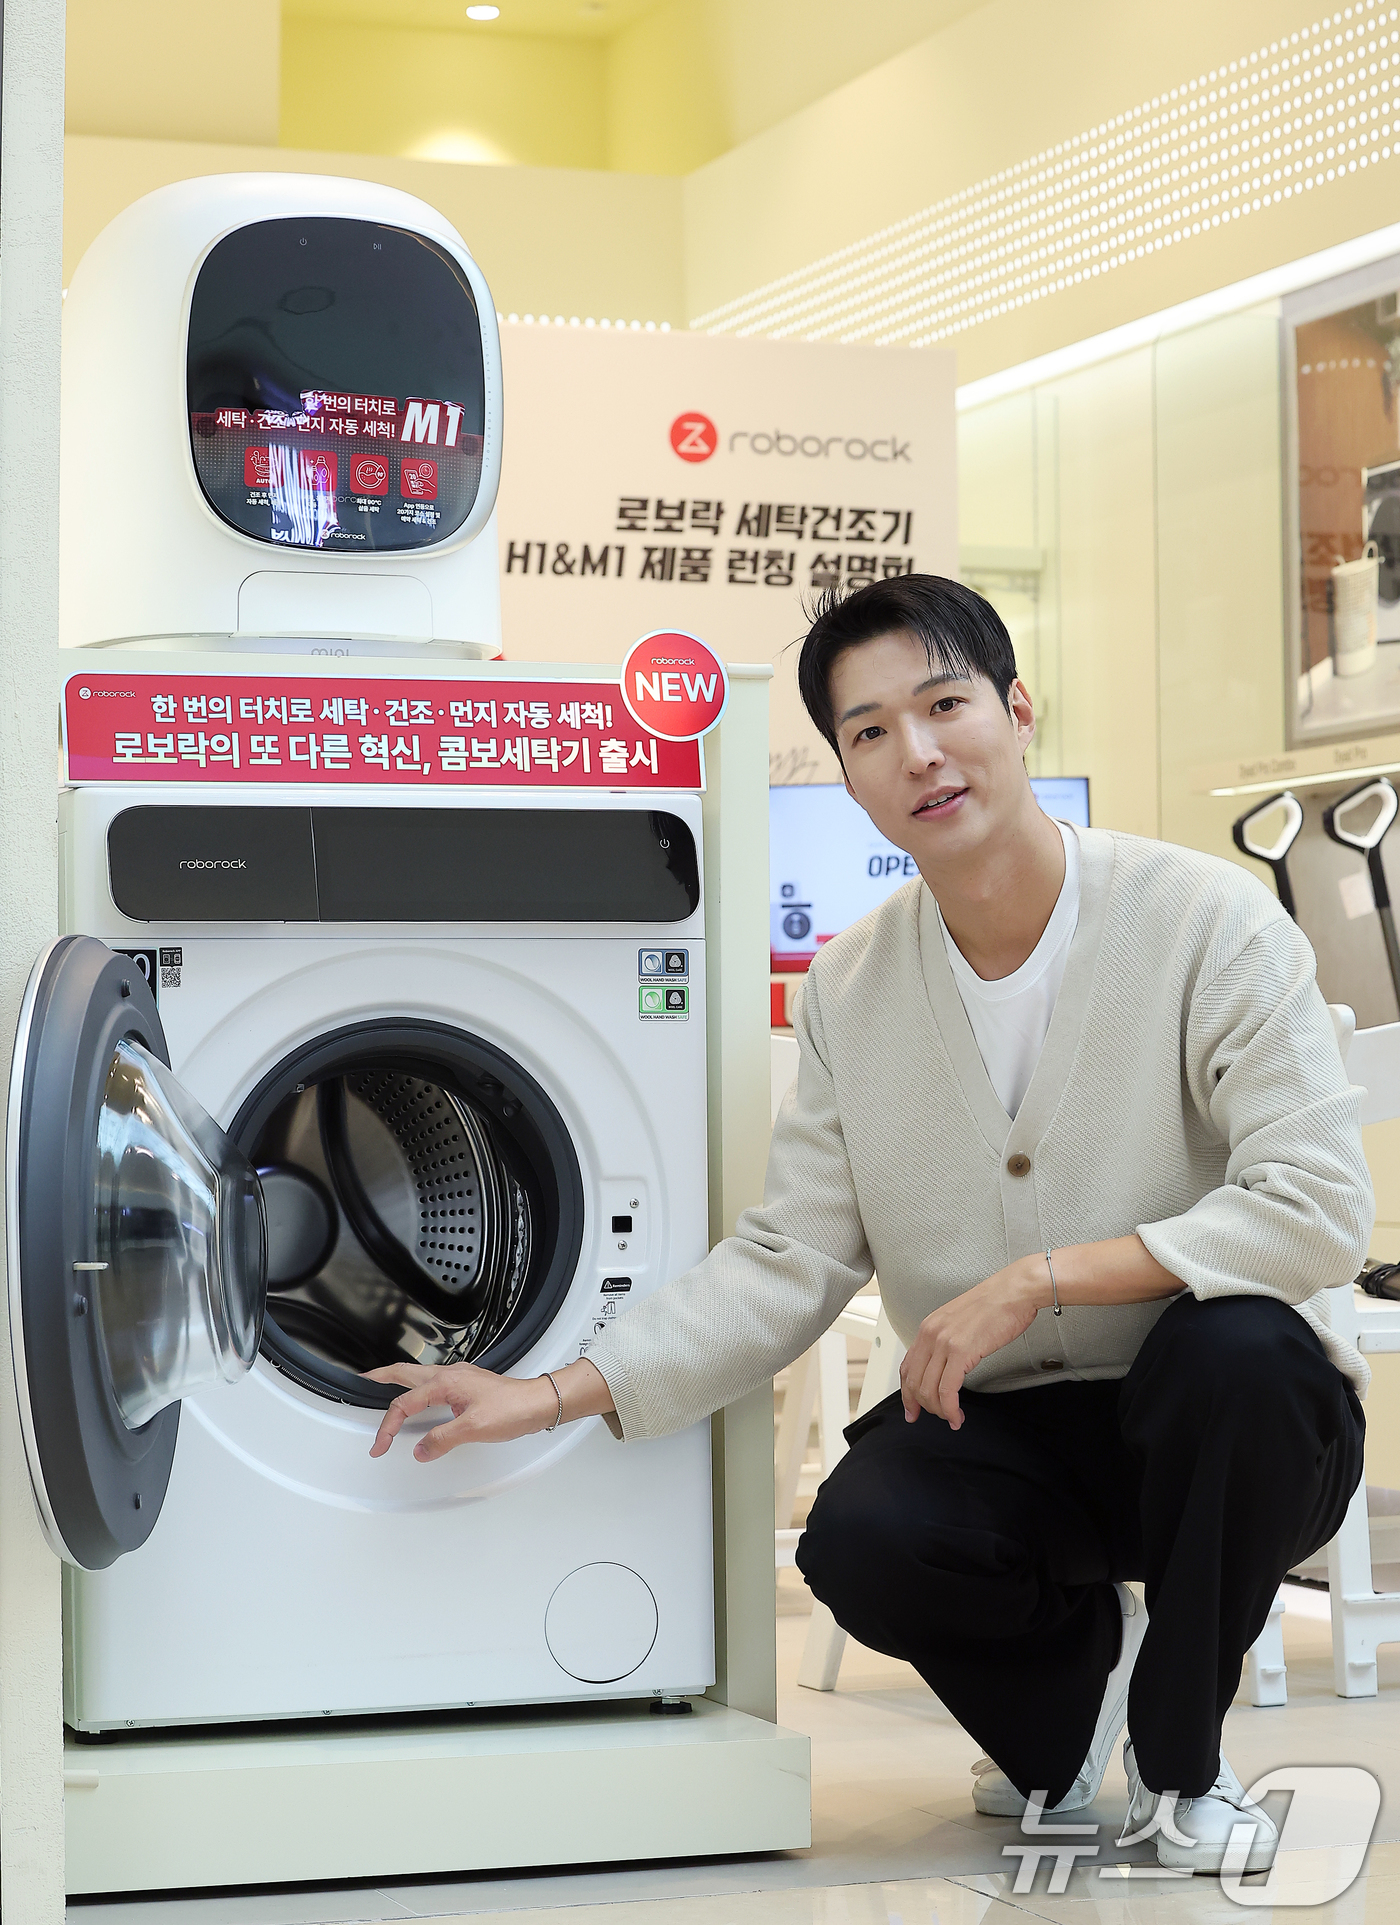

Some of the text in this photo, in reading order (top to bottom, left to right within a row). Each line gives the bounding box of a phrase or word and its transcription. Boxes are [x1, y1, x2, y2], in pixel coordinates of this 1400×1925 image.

[323, 394, 351, 413] 번의
[354, 397, 397, 416] 터치로
[329, 417, 359, 436] 자동
[362, 420, 396, 439] 세척!
[400, 400, 462, 447] M1
[729, 429, 912, 463] roborock
[616, 497, 912, 545] 로보락 세탁건조기
[330, 532, 366, 541] roborock
[506, 541, 625, 577] H1&M1
[640, 546, 713, 583] 제품
[728, 549, 795, 587] 런칭
[651, 657, 695, 666] roborock
[92, 690, 136, 698] roborock
[634, 671, 718, 703] NEW
[150, 694, 178, 723] 한
[183, 694, 233, 724] 번의
[239, 695, 315, 725] 터치로
[503, 700, 552, 729] 자동
[557, 701, 613, 730] 세척!
[112, 731, 659, 776] 로보락의 또 다른 혁신, 콤보세탁기 출시
[179, 858, 247, 869] roborock
[868, 855, 914, 877] OPE
